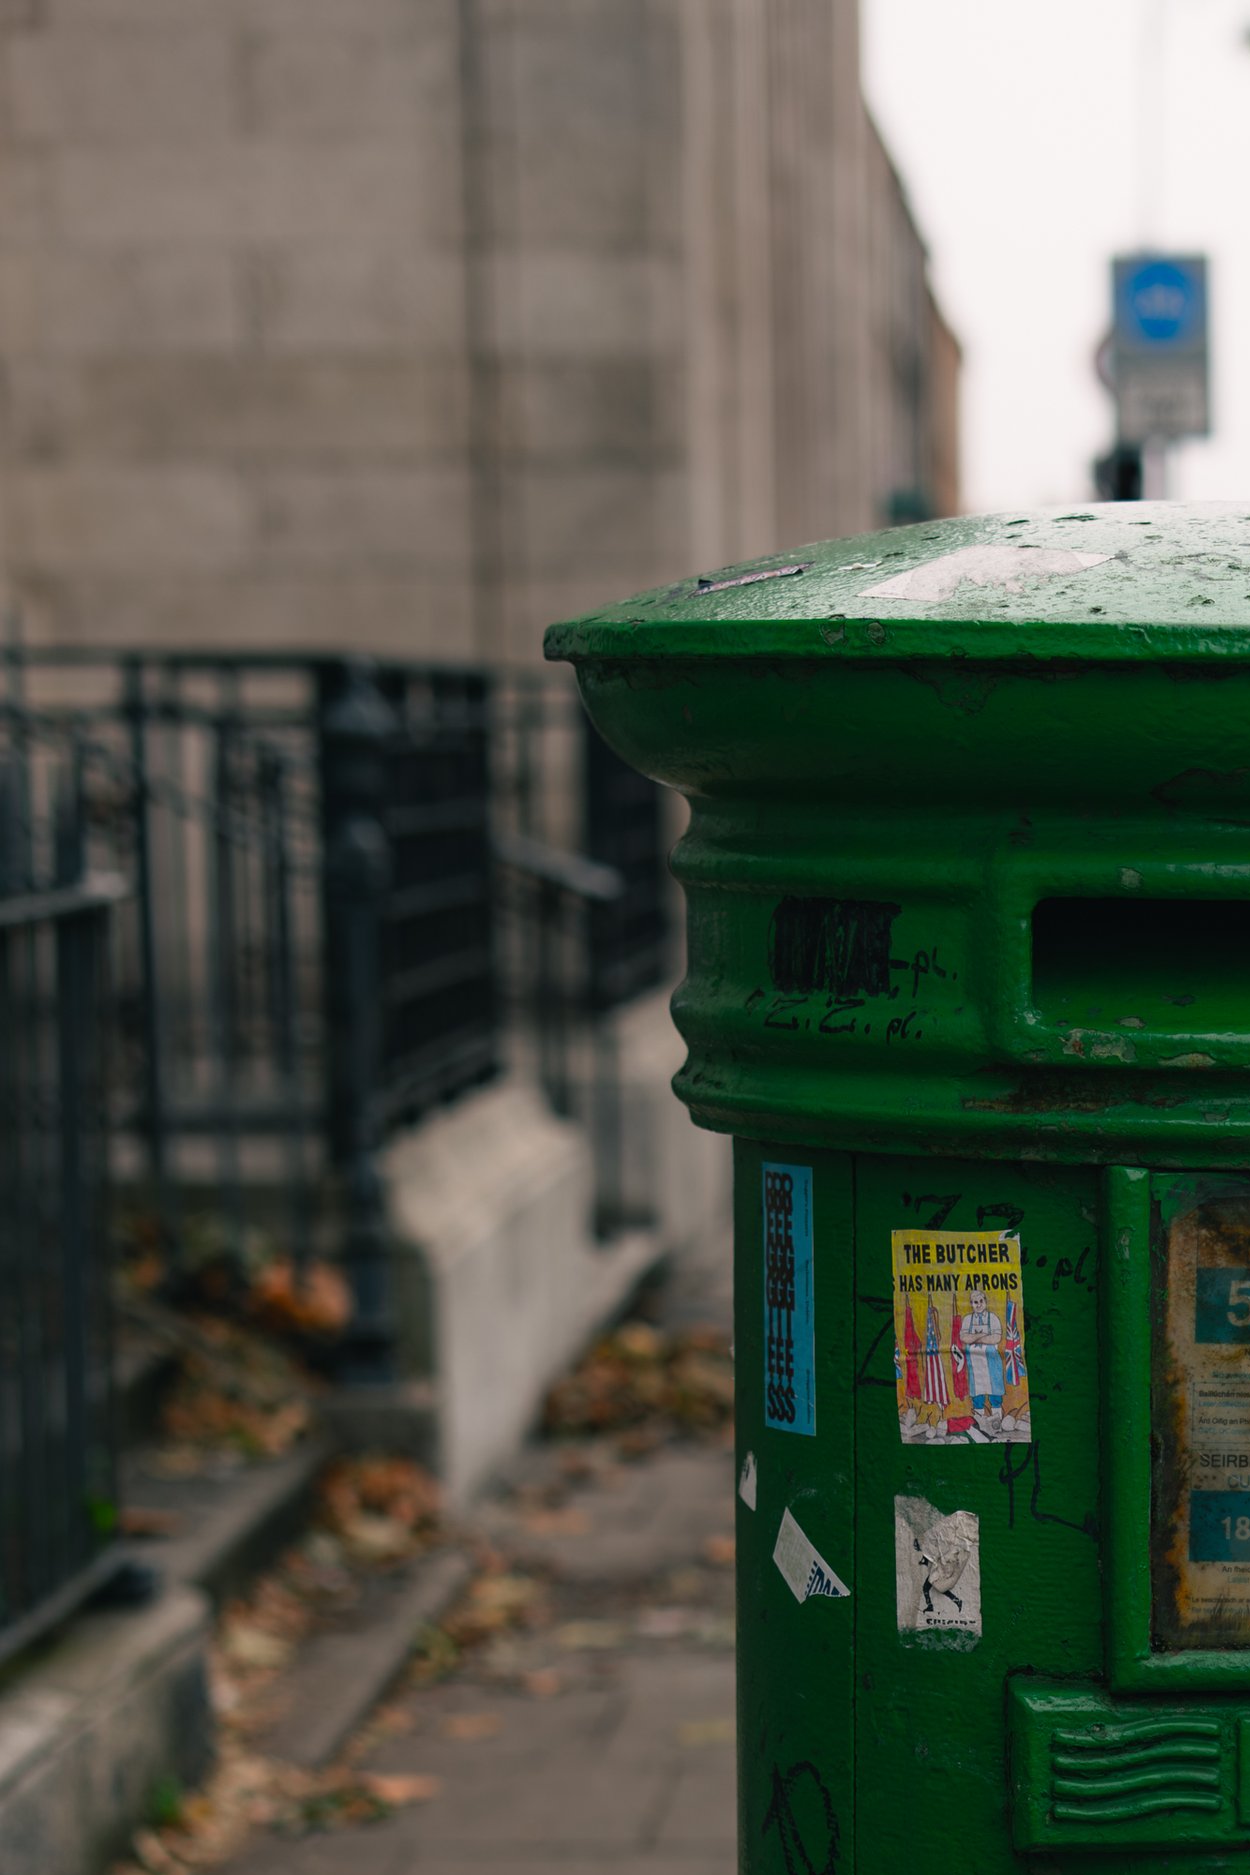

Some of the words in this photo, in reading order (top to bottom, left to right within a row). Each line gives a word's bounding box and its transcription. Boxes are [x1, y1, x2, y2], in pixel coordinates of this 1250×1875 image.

[904, 1244, 931, 1264] THE
[936, 1243, 1010, 1264] BUTCHER
[899, 1274, 923, 1292] HAS
[926, 1274, 961, 1291] MANY
[965, 1272, 1018, 1291] APRONS
